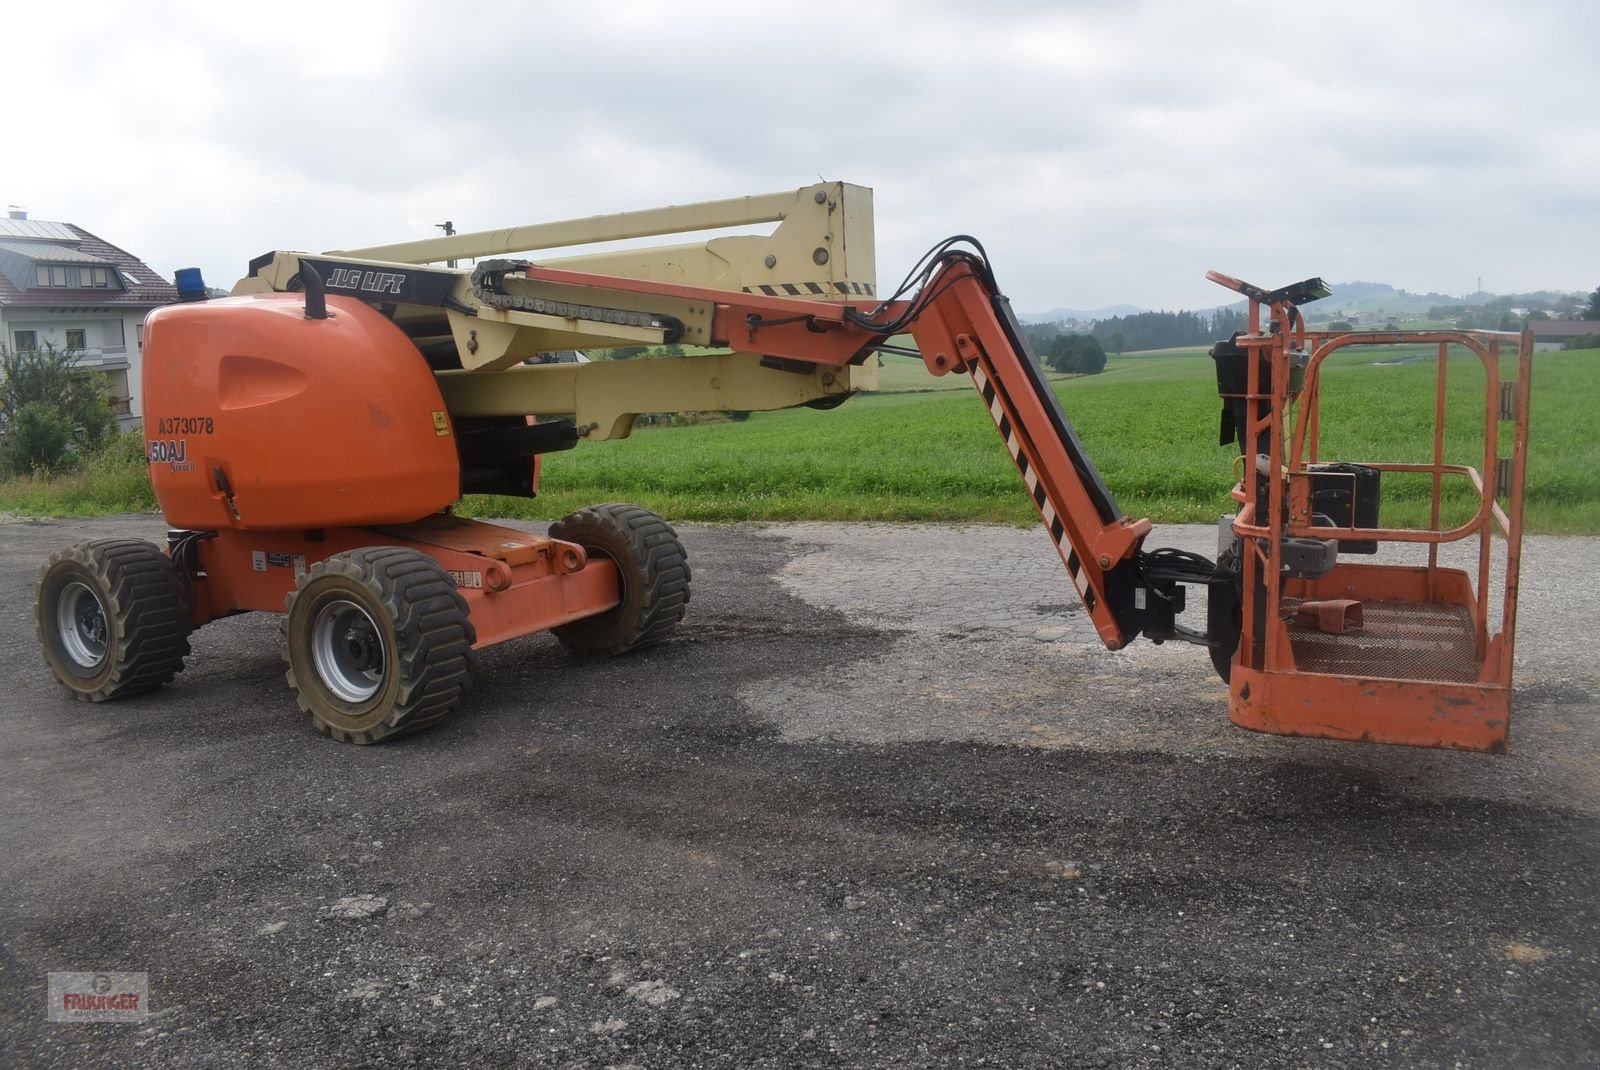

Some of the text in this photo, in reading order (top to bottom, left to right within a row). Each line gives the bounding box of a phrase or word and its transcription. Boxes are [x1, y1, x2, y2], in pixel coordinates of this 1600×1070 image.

[326, 268, 406, 294] JLG LIFT
[158, 417, 214, 435] A373078
